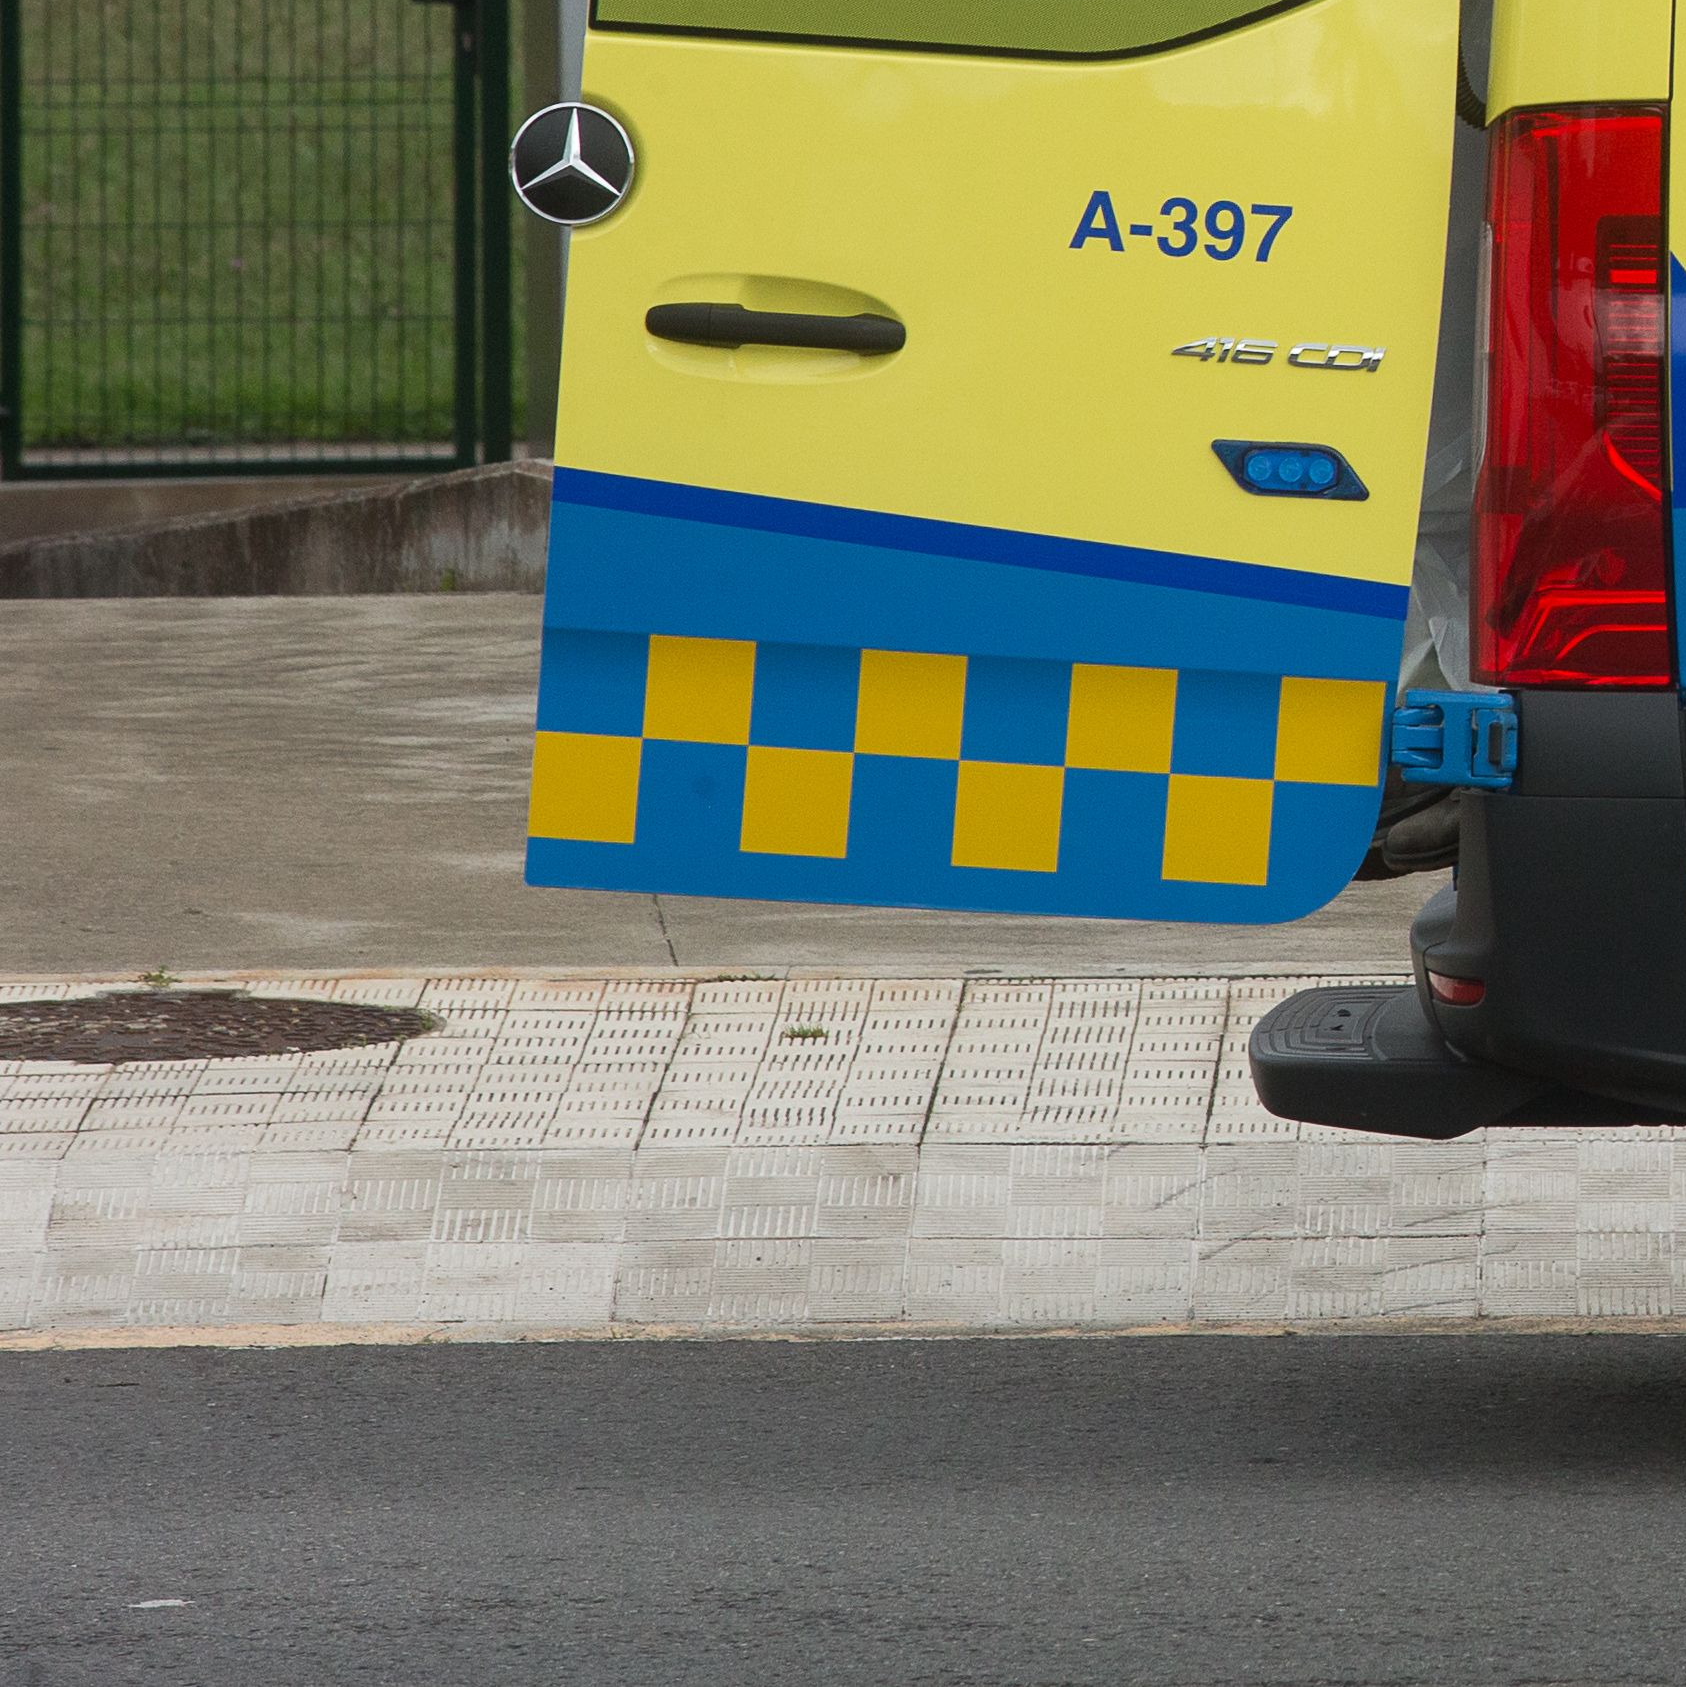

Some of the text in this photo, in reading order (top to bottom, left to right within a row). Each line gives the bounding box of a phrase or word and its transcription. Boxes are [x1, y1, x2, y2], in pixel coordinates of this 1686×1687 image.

[1069, 190, 1294, 263] A-397
[1171, 336, 1387, 373] 416 CDI
